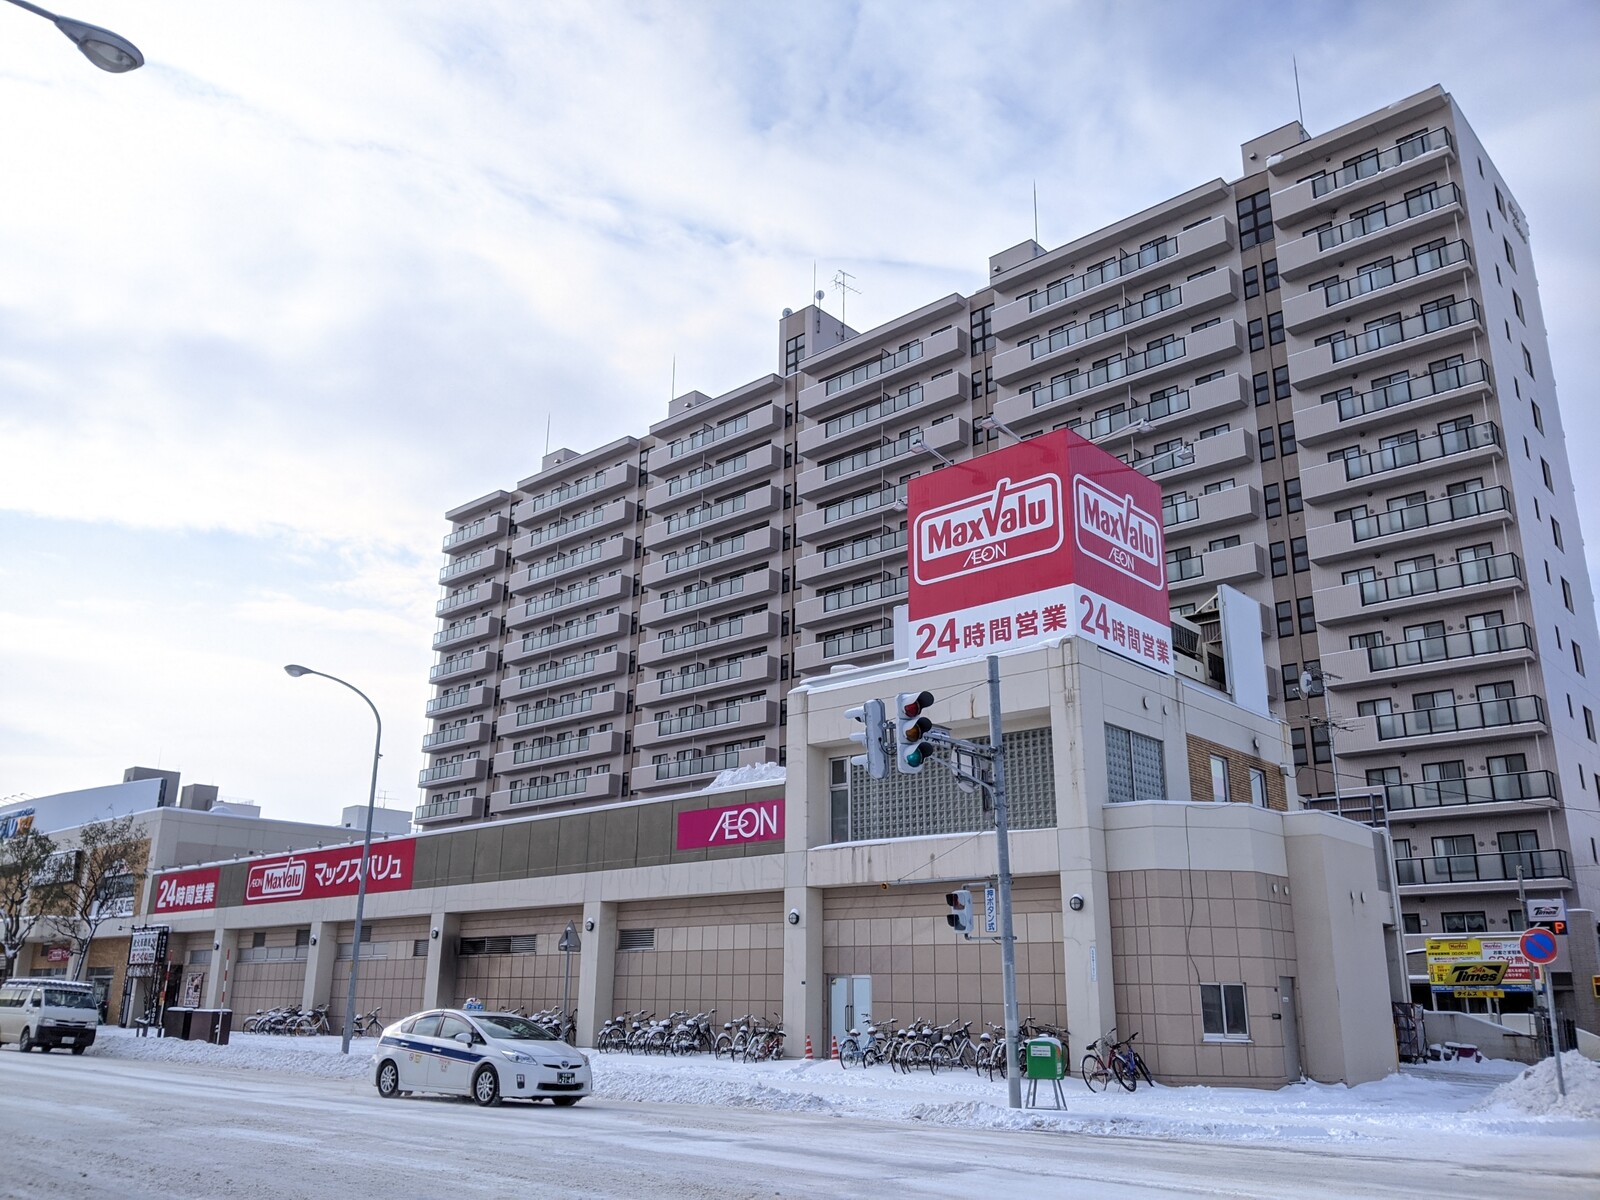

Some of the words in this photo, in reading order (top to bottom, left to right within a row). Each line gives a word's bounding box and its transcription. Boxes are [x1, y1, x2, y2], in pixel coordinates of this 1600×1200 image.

[928, 483, 1047, 554] MaxValu
[1083, 492, 1154, 558] MaxValu
[915, 603, 1068, 660] 24時間営業
[1079, 594, 1170, 666] 24時間営業
[265, 861, 301, 890] MaxValu
[314, 854, 402, 887] マックスバリュ
[157, 879, 215, 908] 24時間営業
[986, 889, 995, 931] 押ボタン式
[1554, 922, 1565, 934] P
[1452, 965, 1501, 982] Times
